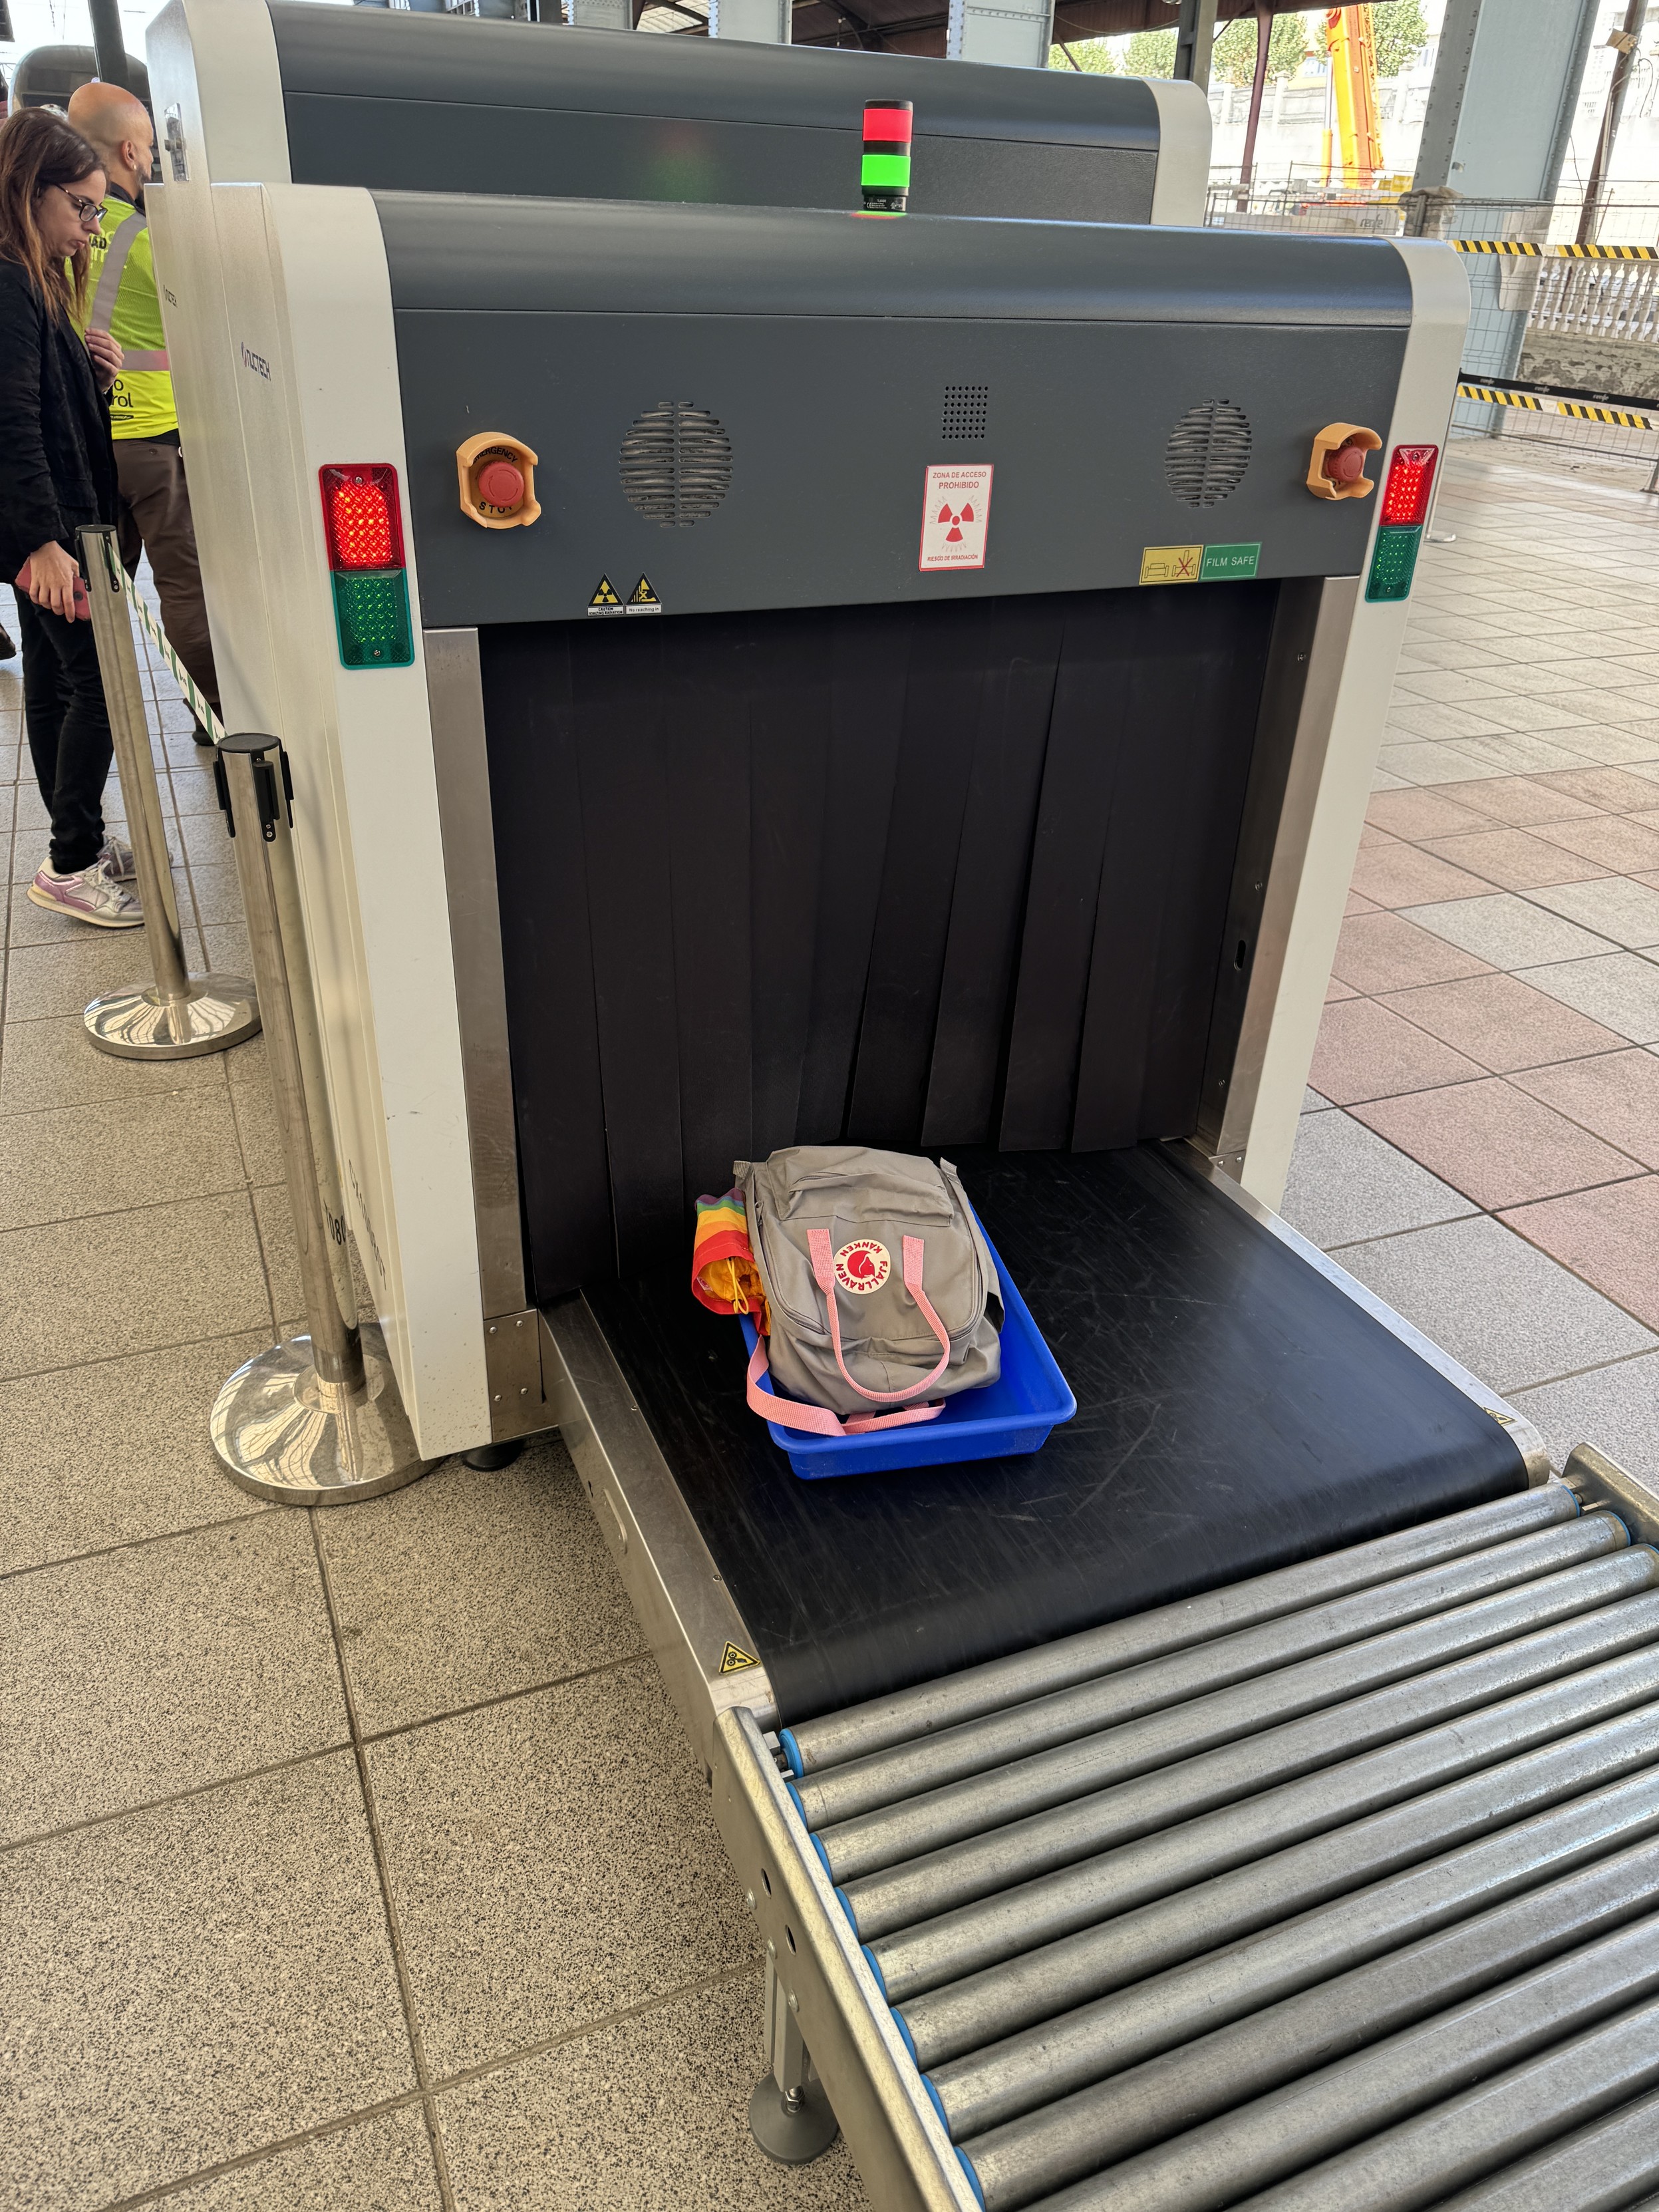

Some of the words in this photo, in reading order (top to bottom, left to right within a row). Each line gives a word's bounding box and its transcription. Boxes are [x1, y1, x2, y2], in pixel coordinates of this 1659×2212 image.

[1360, 214, 1383, 233] renfe
[479, 502, 512, 514] STO
[1206, 557, 1227, 567] FILM
[1231, 555, 1255, 565] SAFE
